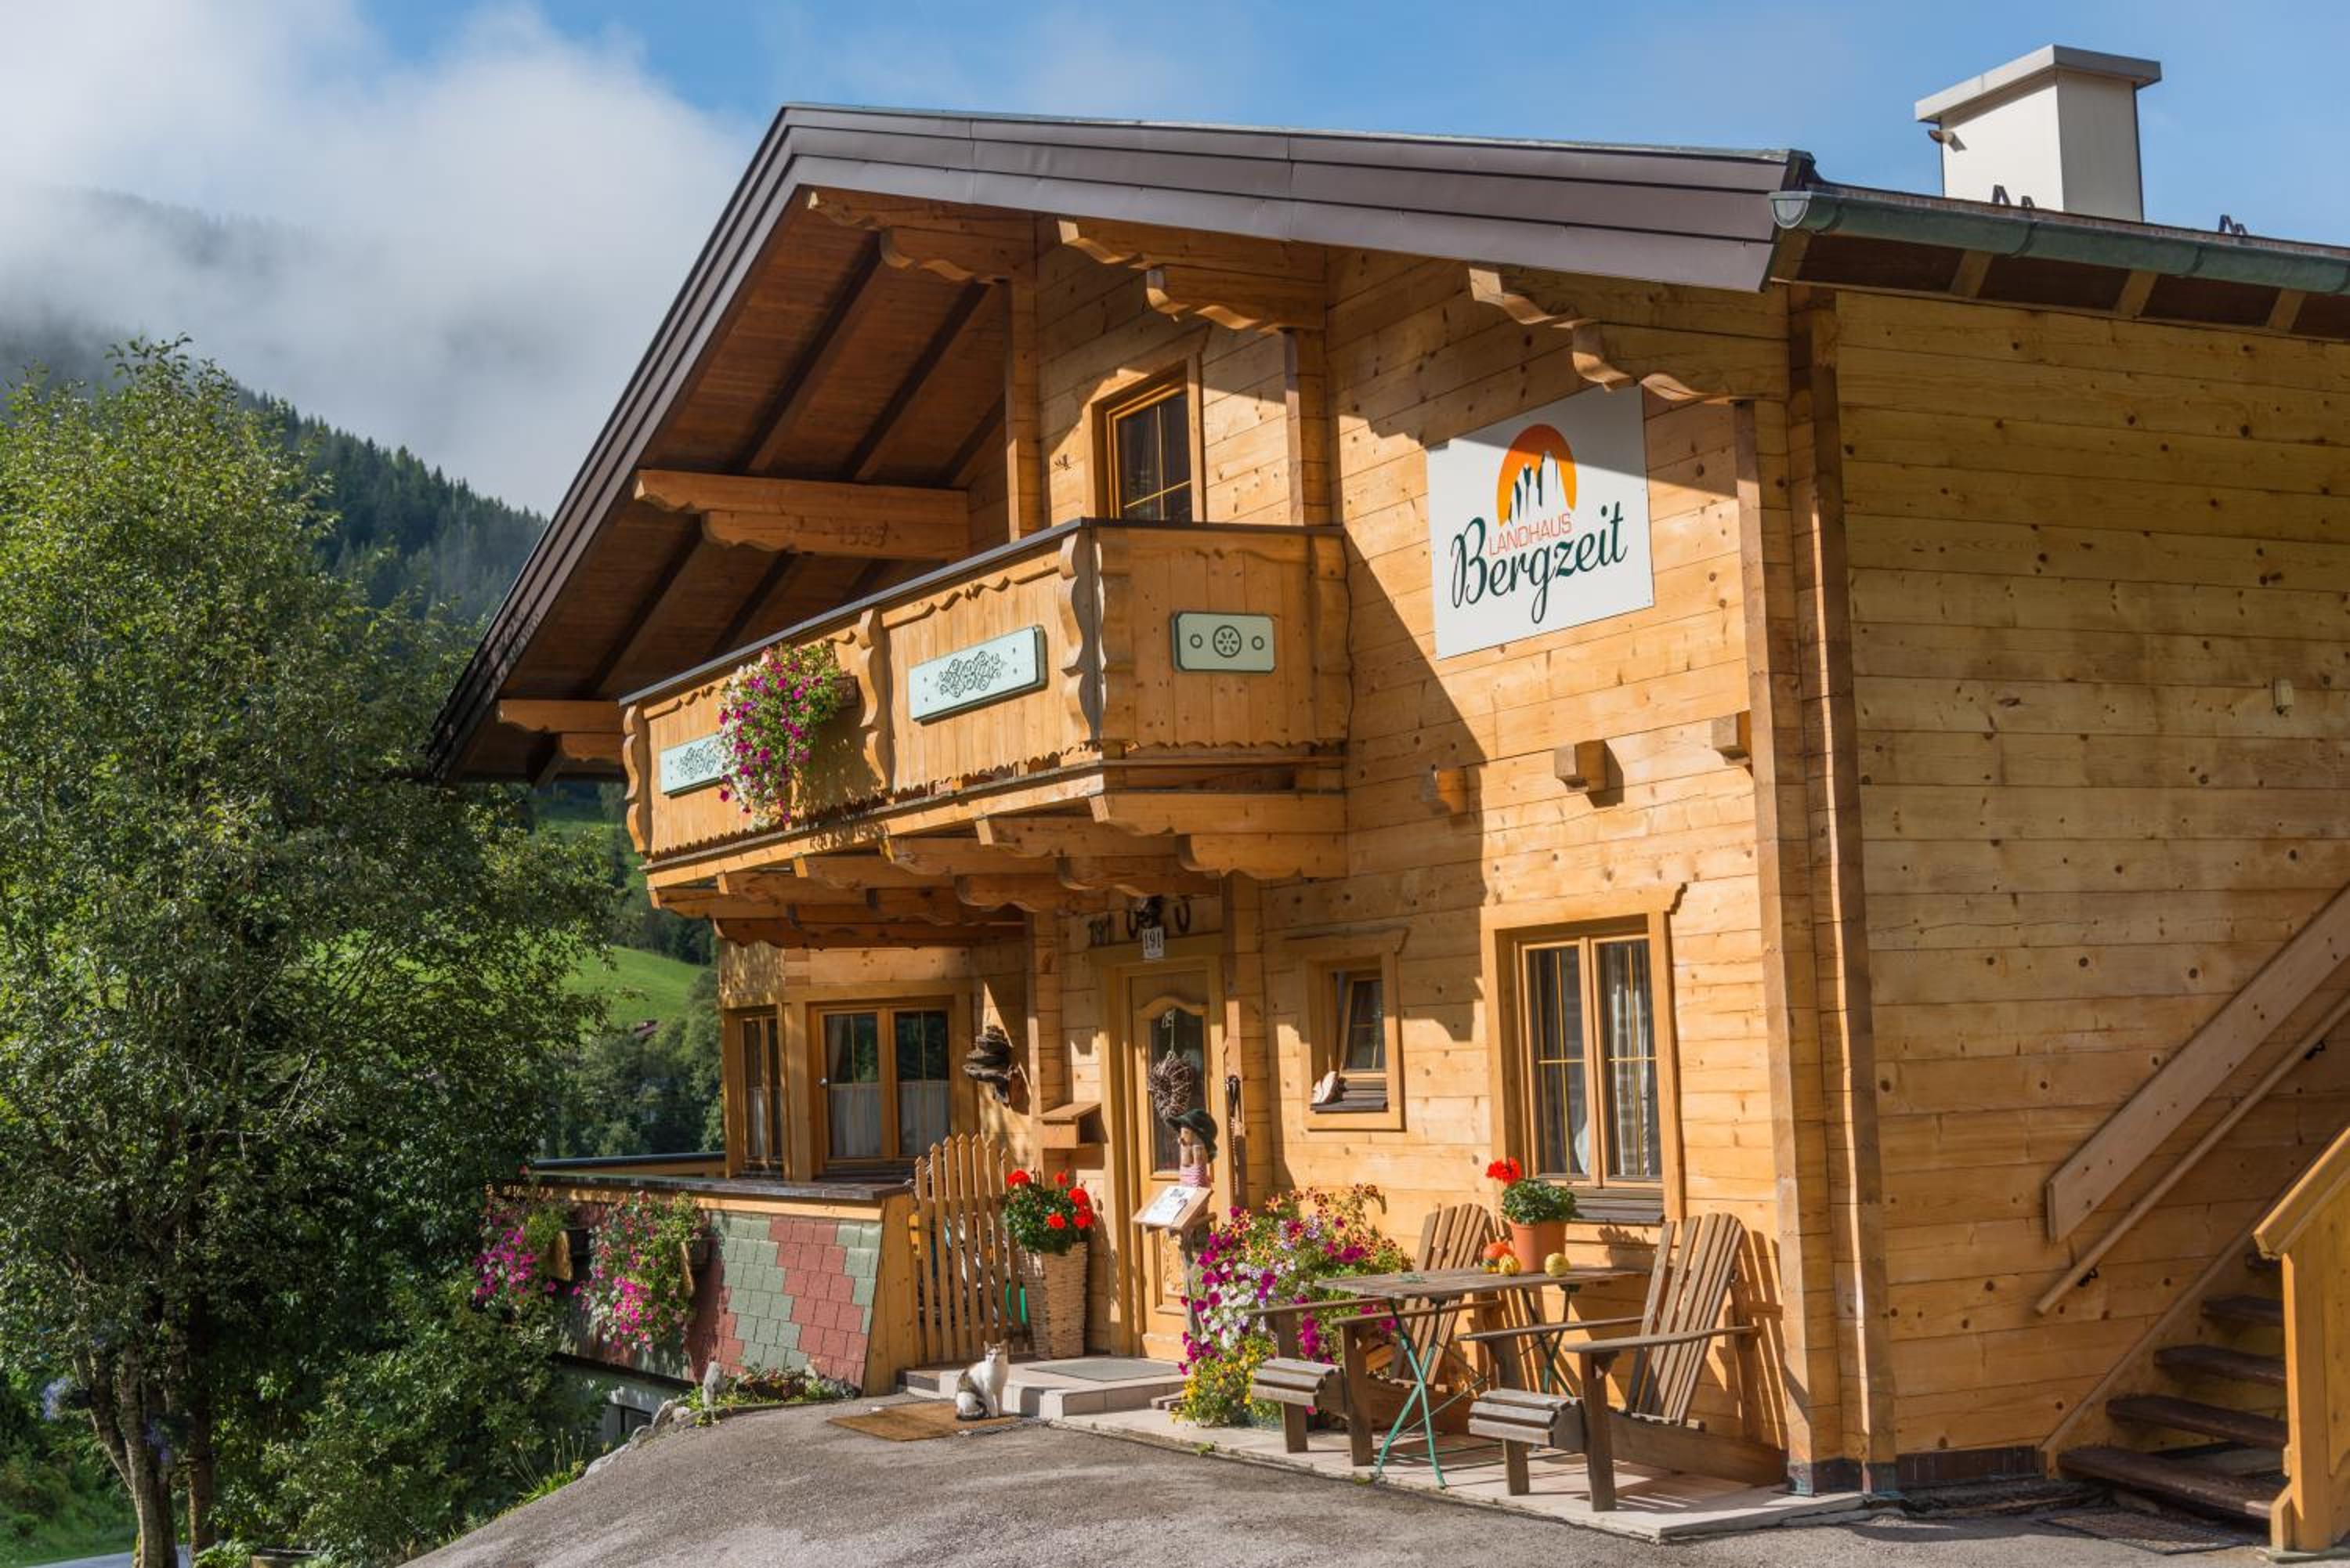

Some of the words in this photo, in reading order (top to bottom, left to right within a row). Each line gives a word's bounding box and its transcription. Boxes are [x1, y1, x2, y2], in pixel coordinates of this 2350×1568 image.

[1488, 513, 1572, 555] LANDHAUS
[1450, 501, 1629, 624] Bergzeit
[1144, 930, 1162, 950] 191
